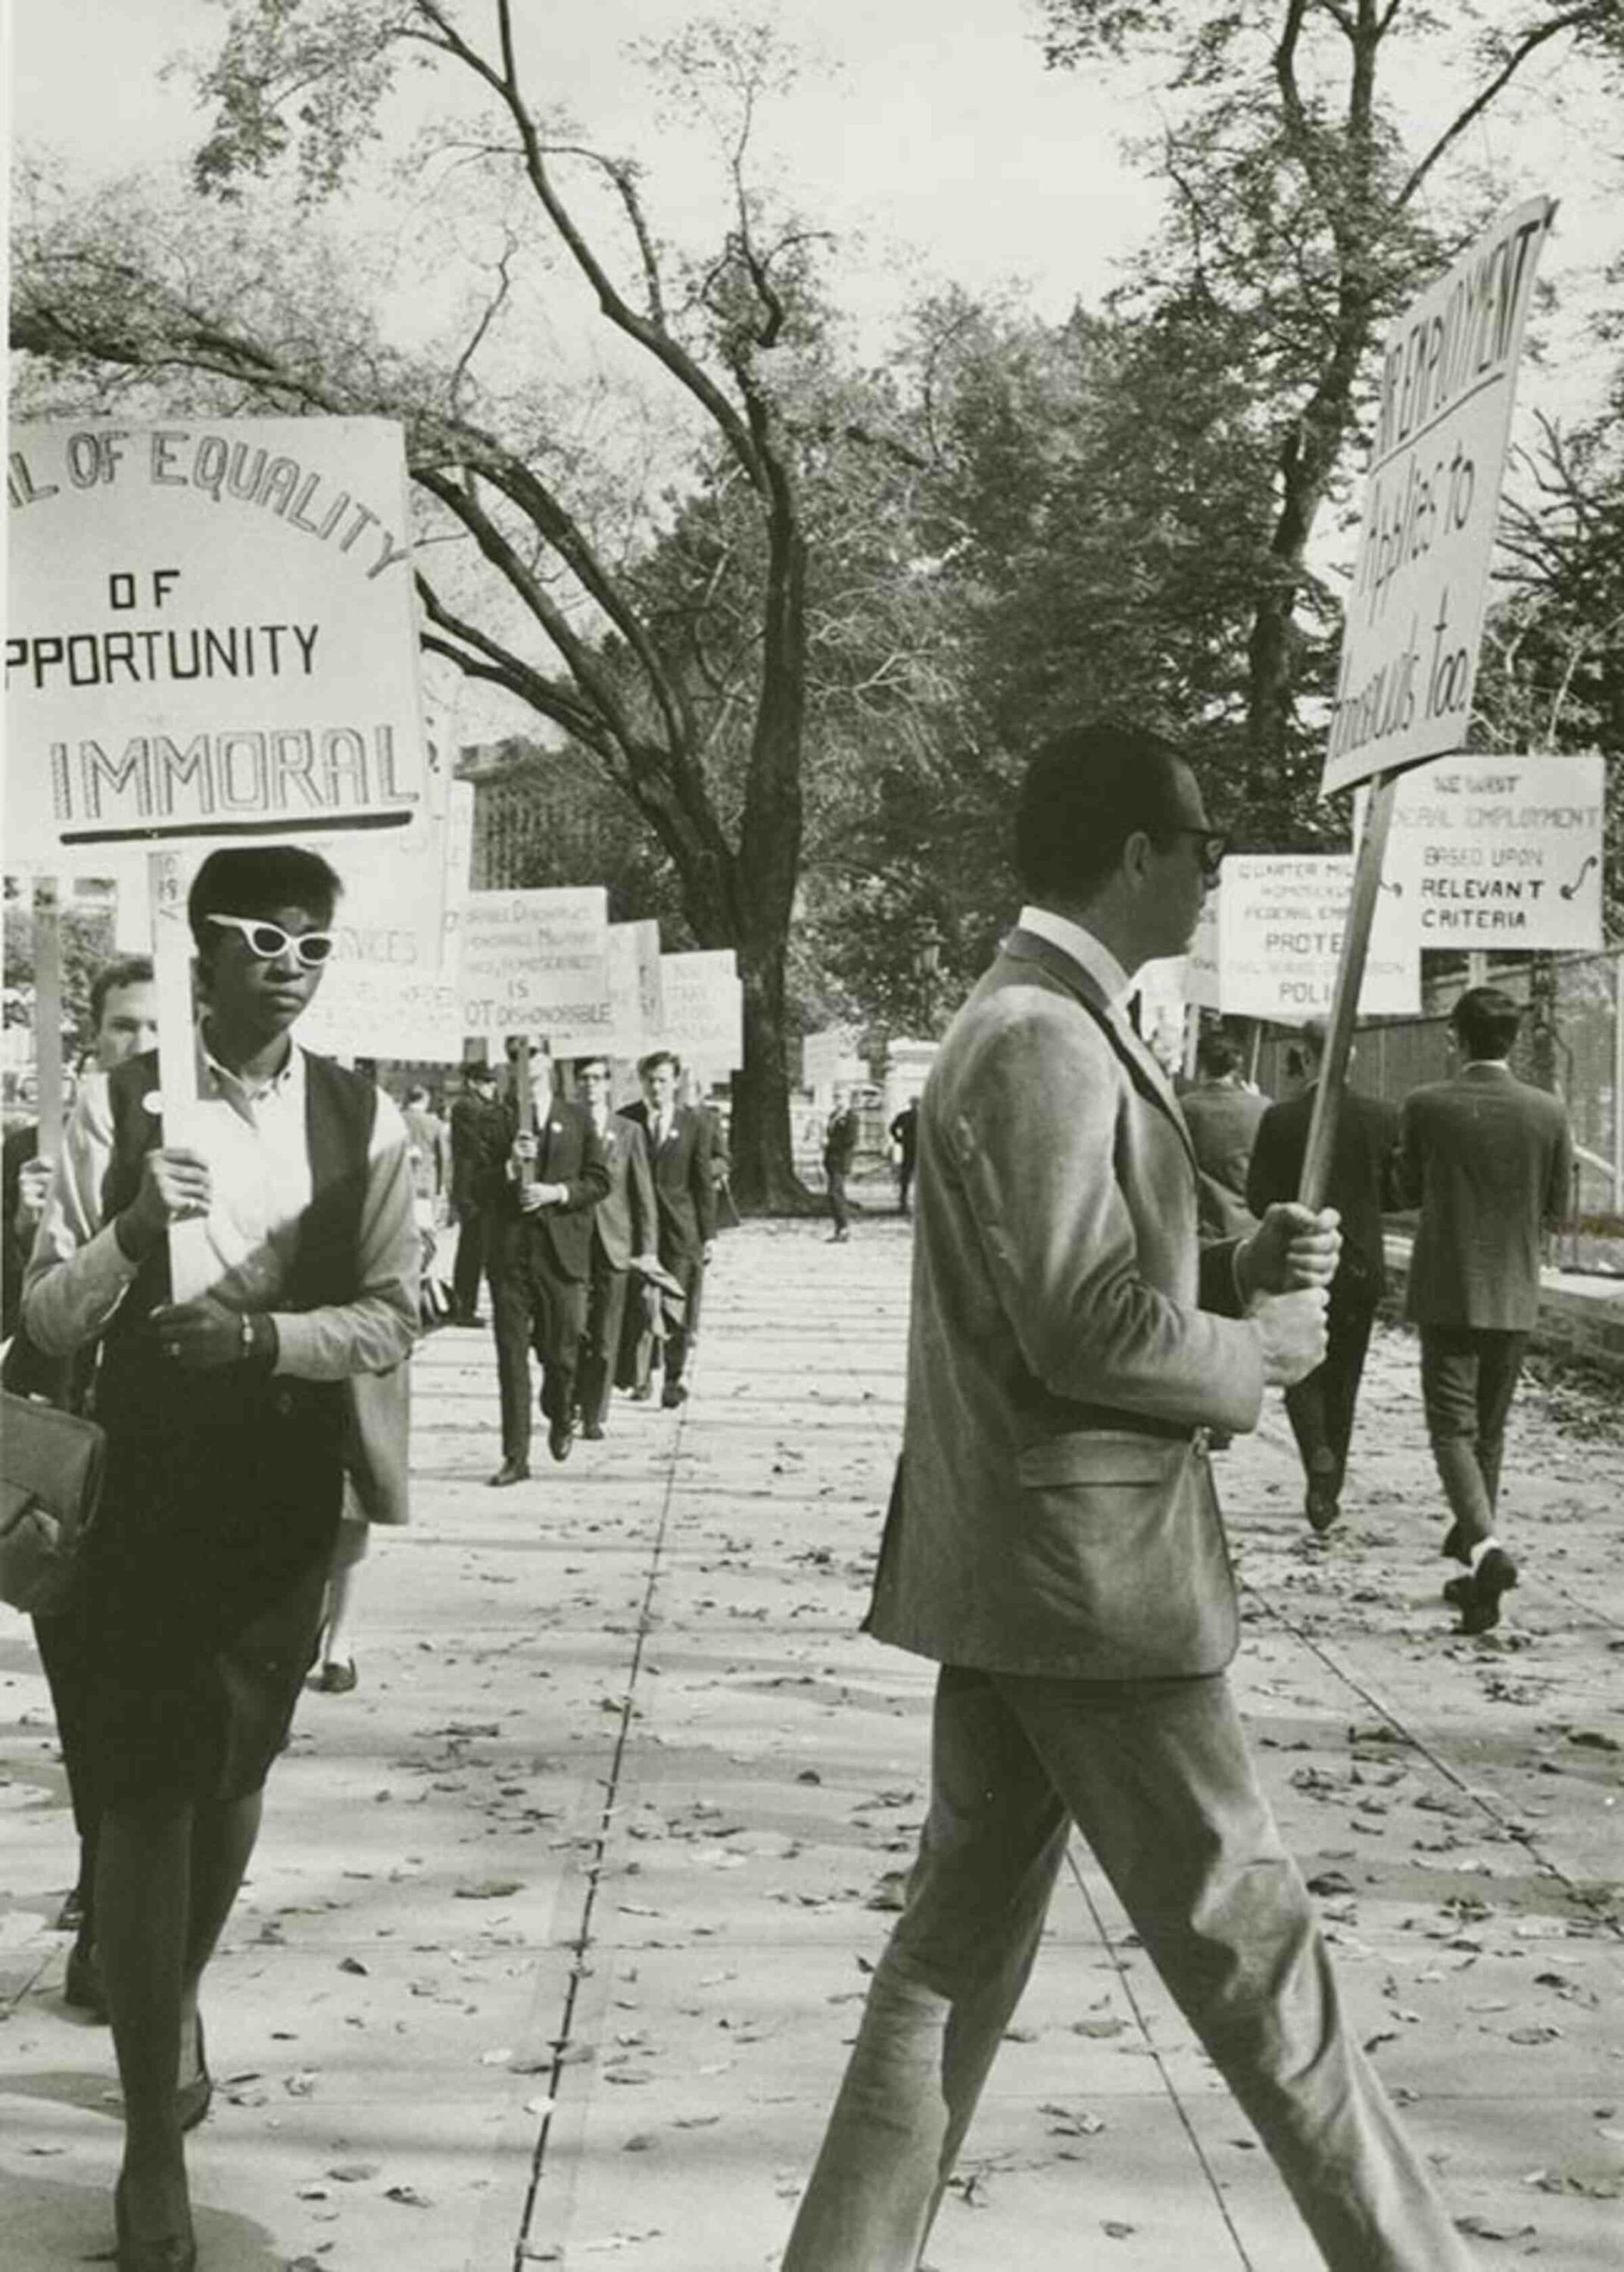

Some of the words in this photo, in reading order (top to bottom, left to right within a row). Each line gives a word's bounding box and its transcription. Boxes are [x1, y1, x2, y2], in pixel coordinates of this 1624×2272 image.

[67, 432, 129, 489] OF
[151, 432, 409, 580] EQUALITY
[110, 570, 180, 610] OF
[50, 725, 419, 820] IMMORAL
[1492, 846, 1543, 868] UPON
[1421, 879, 1545, 900] RELEVANT
[1421, 909, 1528, 928] CRITERIA
[508, 979, 529, 998] IS
